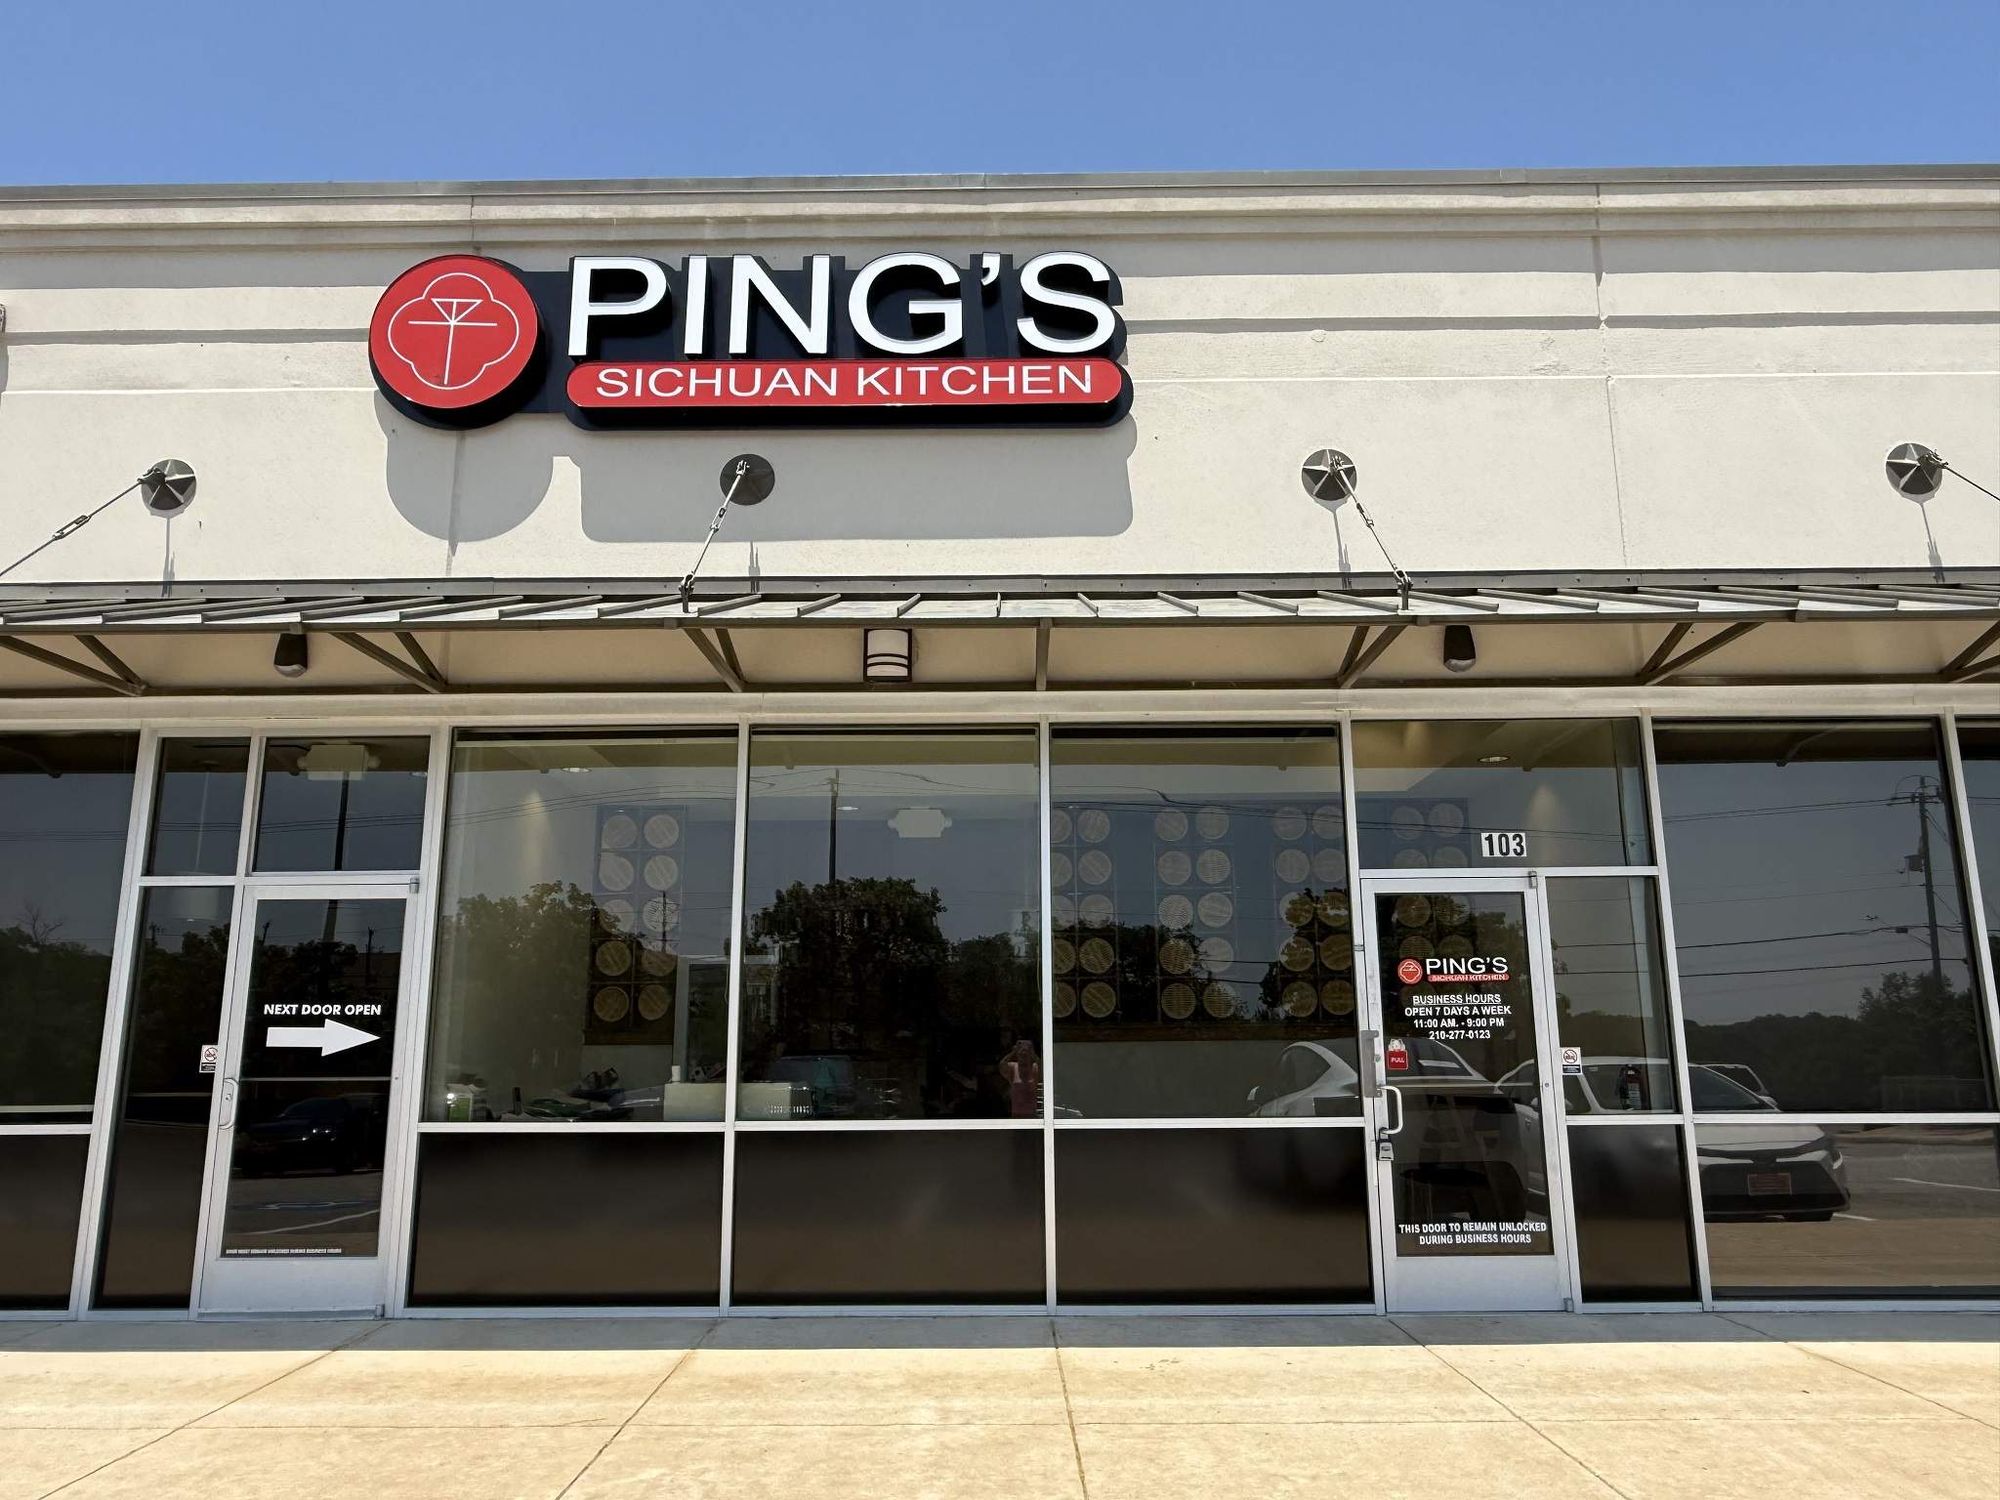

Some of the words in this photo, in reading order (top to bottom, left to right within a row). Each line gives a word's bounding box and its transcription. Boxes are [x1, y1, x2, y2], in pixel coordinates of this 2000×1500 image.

[568, 252, 1115, 356] PING'S
[595, 365, 839, 398] SICHUAN
[856, 364, 1093, 395] KITCHEN
[1484, 834, 1525, 856] 103
[1425, 957, 1509, 975] PING'S
[1412, 994, 1463, 1004] BUSINESS
[1465, 993, 1501, 1004] HOURS
[263, 1004, 299, 1015] NEXT
[301, 1004, 341, 1015] DOOR
[344, 1004, 382, 1015] OPEN
[1404, 1006, 1433, 1017] OPEN
[1434, 1006, 1440, 1016] 7
[1443, 1006, 1470, 1016] DAYS
[1471, 1006, 1480, 1015] A
[1480, 1005, 1512, 1015] WEEK
[1413, 1019, 1438, 1028] 11:00
[1466, 1018, 1487, 1027] 9:00
[1489, 1017, 1505, 1027] PM
[1428, 1030, 1491, 1039] 210-277-0123
[1390, 1056, 1405, 1064] PULL
[1398, 1224, 1421, 1234] THIS
[1422, 1223, 1447, 1233] DOOR
[1448, 1223, 1461, 1233] TO
[1462, 1222, 1497, 1232] REMAIN
[1499, 1222, 1547, 1232] UNLOCKED
[1419, 1235, 1454, 1245] DURING
[1455, 1234, 1499, 1244] BUSINESS
[1500, 1233, 1532, 1243] HOURS
